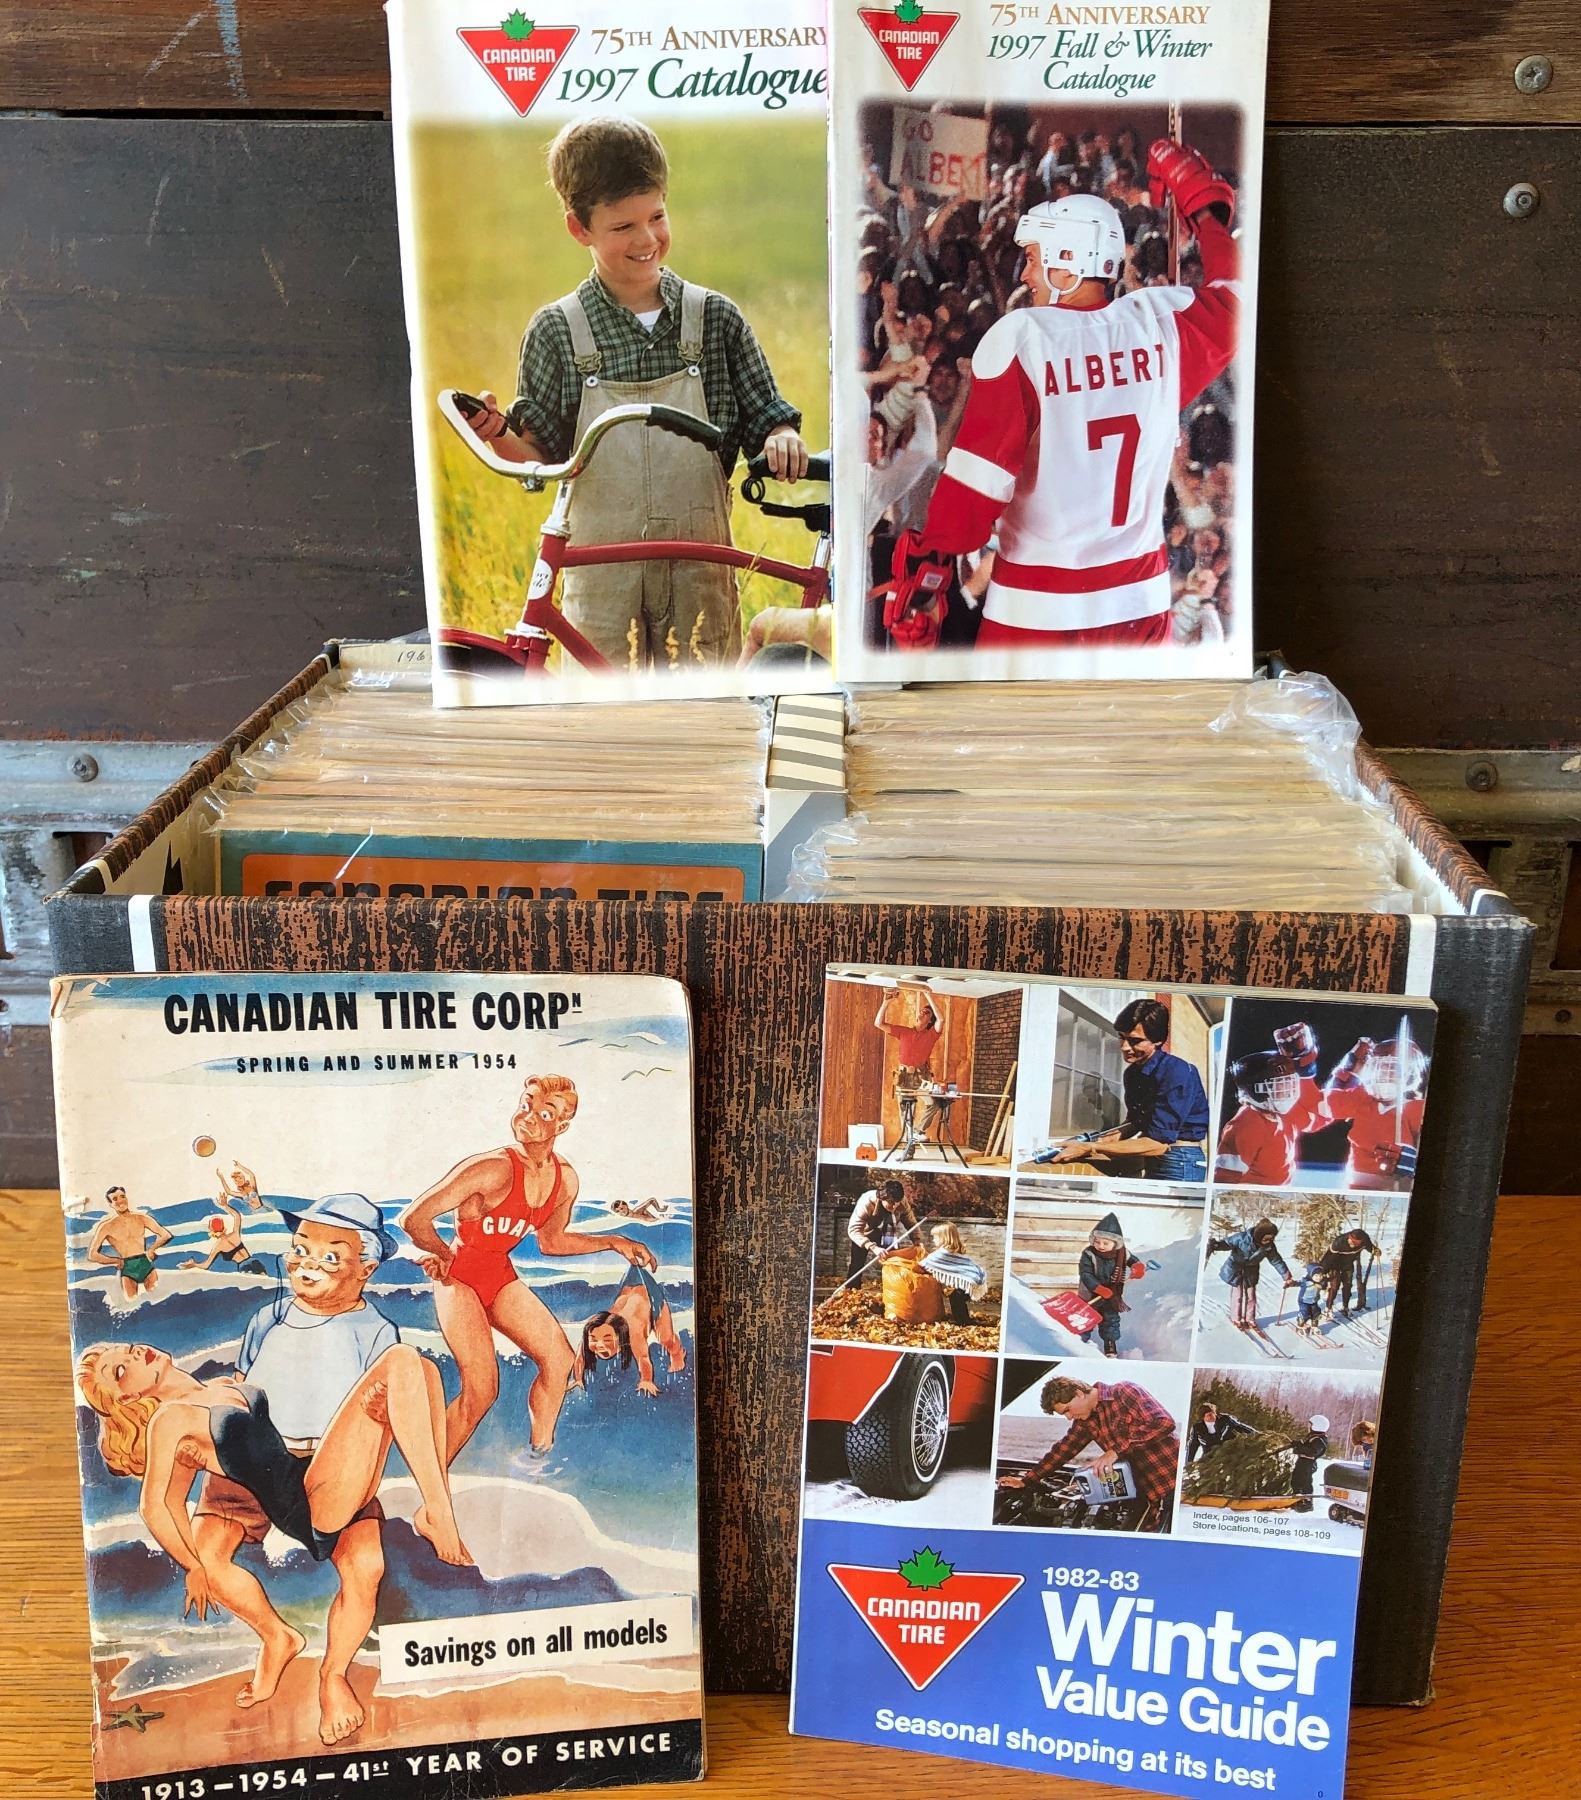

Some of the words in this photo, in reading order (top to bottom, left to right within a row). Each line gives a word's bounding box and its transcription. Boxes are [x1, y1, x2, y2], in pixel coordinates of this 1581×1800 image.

[990, 3, 1039, 26] 75TH
[1046, 3, 1211, 25] ANNIVERSARY
[591, 27, 651, 54] 75TH
[878, 30, 940, 45] CANADIAN
[987, 35, 1047, 59] 1997
[1051, 30, 1099, 58] Fall
[1104, 31, 1130, 58] &
[1134, 29, 1212, 59] Winter
[482, 48, 556, 65] CANADIAN
[896, 46, 923, 60] TIRE
[505, 66, 536, 82] TIRE
[556, 68, 639, 102] 1997
[647, 53, 827, 110] Catalogue
[1044, 61, 1156, 98] Catalogue
[1045, 344, 1163, 396] ALBERT
[1087, 414, 1141, 527] 7
[164, 991, 358, 1034] CANADIAN
[374, 991, 457, 1030] TIRE
[236, 1057, 310, 1074] SPRING
[323, 1056, 361, 1071] AND
[374, 1054, 459, 1071] SUMMER
[472, 1053, 517, 1070] 1954
[1192, 1521, 1216, 1531] Store
[1263, 1527, 1291, 1538] pages
[1294, 1529, 1332, 1541] 108-109
[1193, 1511, 1220, 1522] Index,
[1222, 1514, 1250, 1525] pages
[1253, 1515, 1290, 1526] 106-107
[1042, 1566, 1140, 1593] 1982-83
[866, 1597, 981, 1623] CANADIAN
[404, 1637, 496, 1667] Savings
[506, 1635, 535, 1658] on
[546, 1625, 572, 1654] all
[584, 1617, 667, 1650] models
[898, 1623, 945, 1646] TIRE
[1041, 1590, 1337, 1696] Winter
[1036, 1665, 1169, 1726] Value
[1179, 1687, 1331, 1751] Guide
[405, 1750, 483, 1777] YEAR
[502, 1744, 538, 1767] OF
[556, 1732, 672, 1762] SERVICE
[875, 1708, 1000, 1746] Seasonal
[1006, 1727, 1134, 1772] shopping
[1141, 1750, 1168, 1773] at
[1175, 1751, 1207, 1780] its
[1215, 1758, 1276, 1791] best
